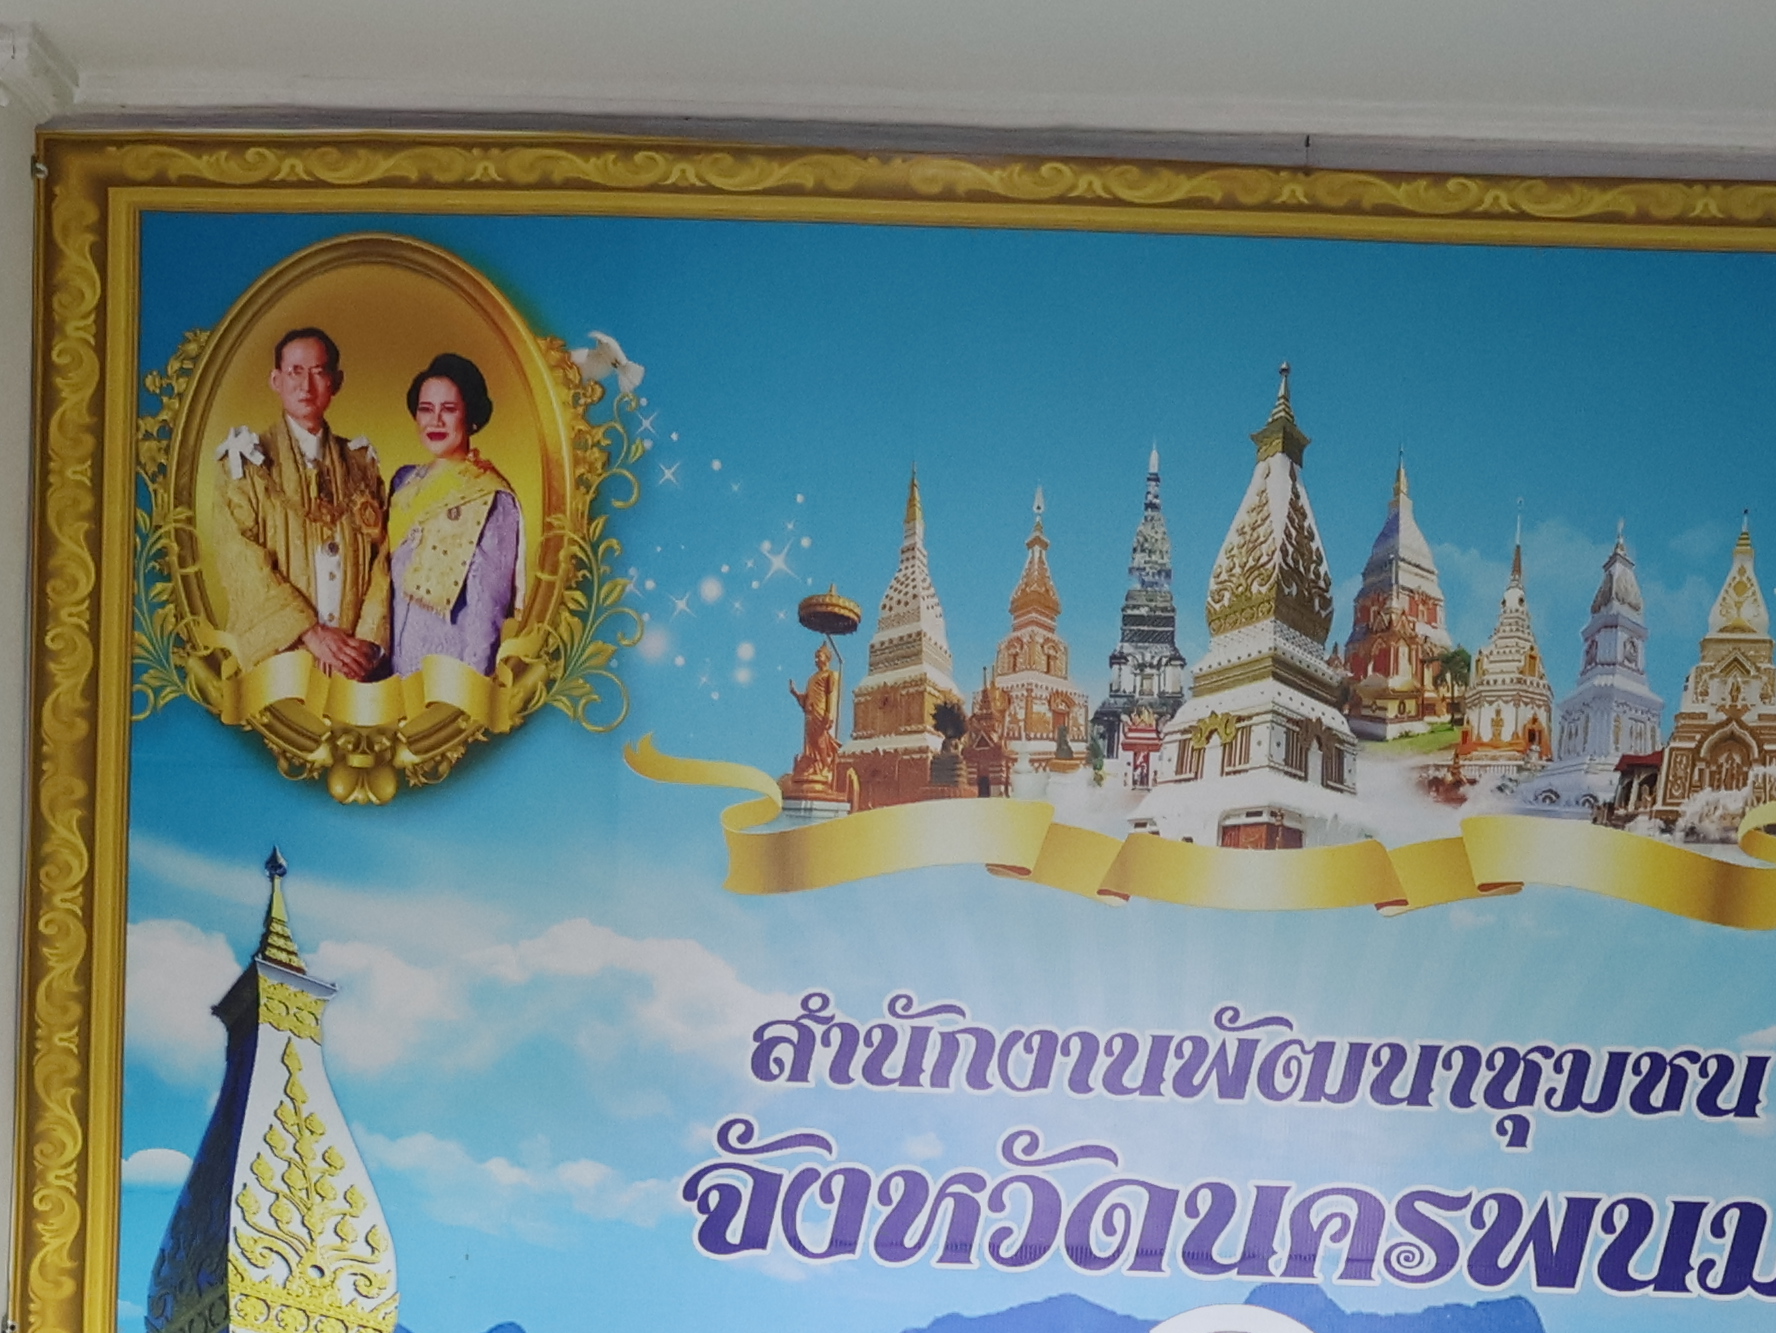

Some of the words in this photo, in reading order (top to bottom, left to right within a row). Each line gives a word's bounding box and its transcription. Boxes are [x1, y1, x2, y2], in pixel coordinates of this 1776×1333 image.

[749, 991, 1771, 1149] สำนักงานพัฒนาชุมชน
